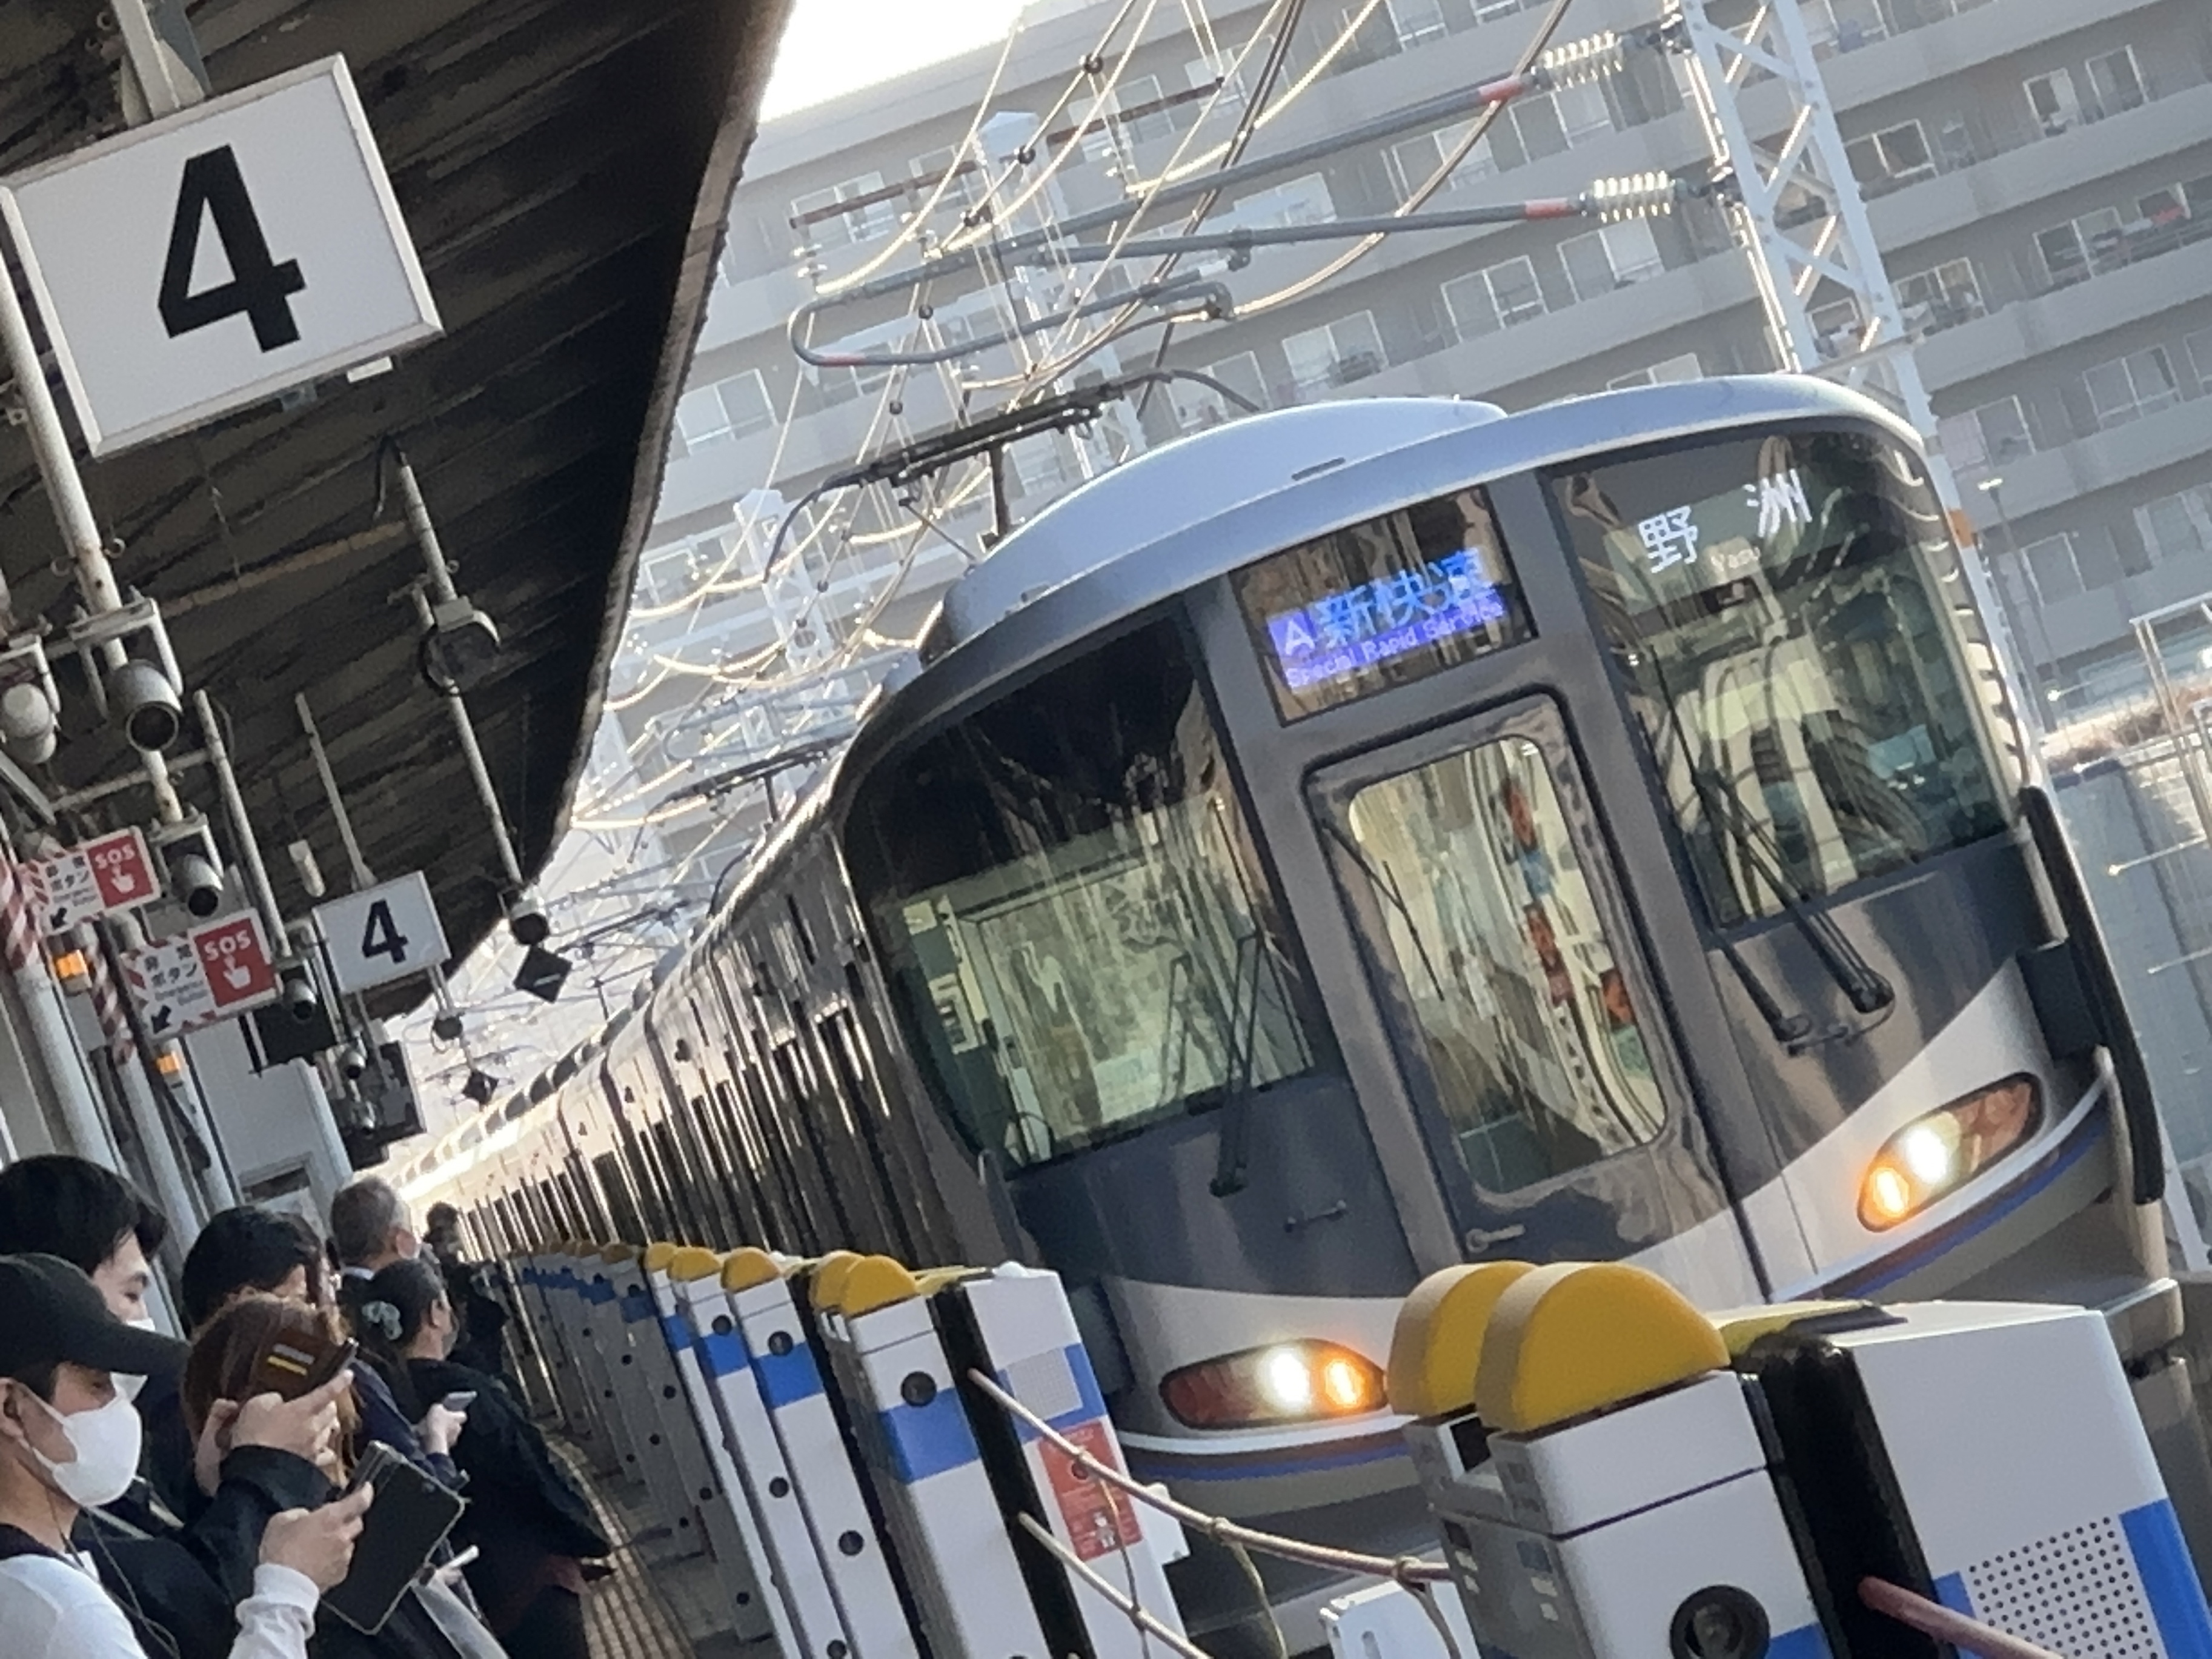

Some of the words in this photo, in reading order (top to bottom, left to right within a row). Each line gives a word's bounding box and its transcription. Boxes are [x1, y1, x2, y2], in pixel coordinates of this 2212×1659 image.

[158, 144, 306, 353] 4
[1317, 547, 1493, 648] 新快速
[1285, 620, 1315, 655] A
[1361, 631, 1419, 662] Rapid
[95, 843, 135, 869] SOS
[204, 929, 251, 961] SOS
[362, 900, 408, 963] 4
